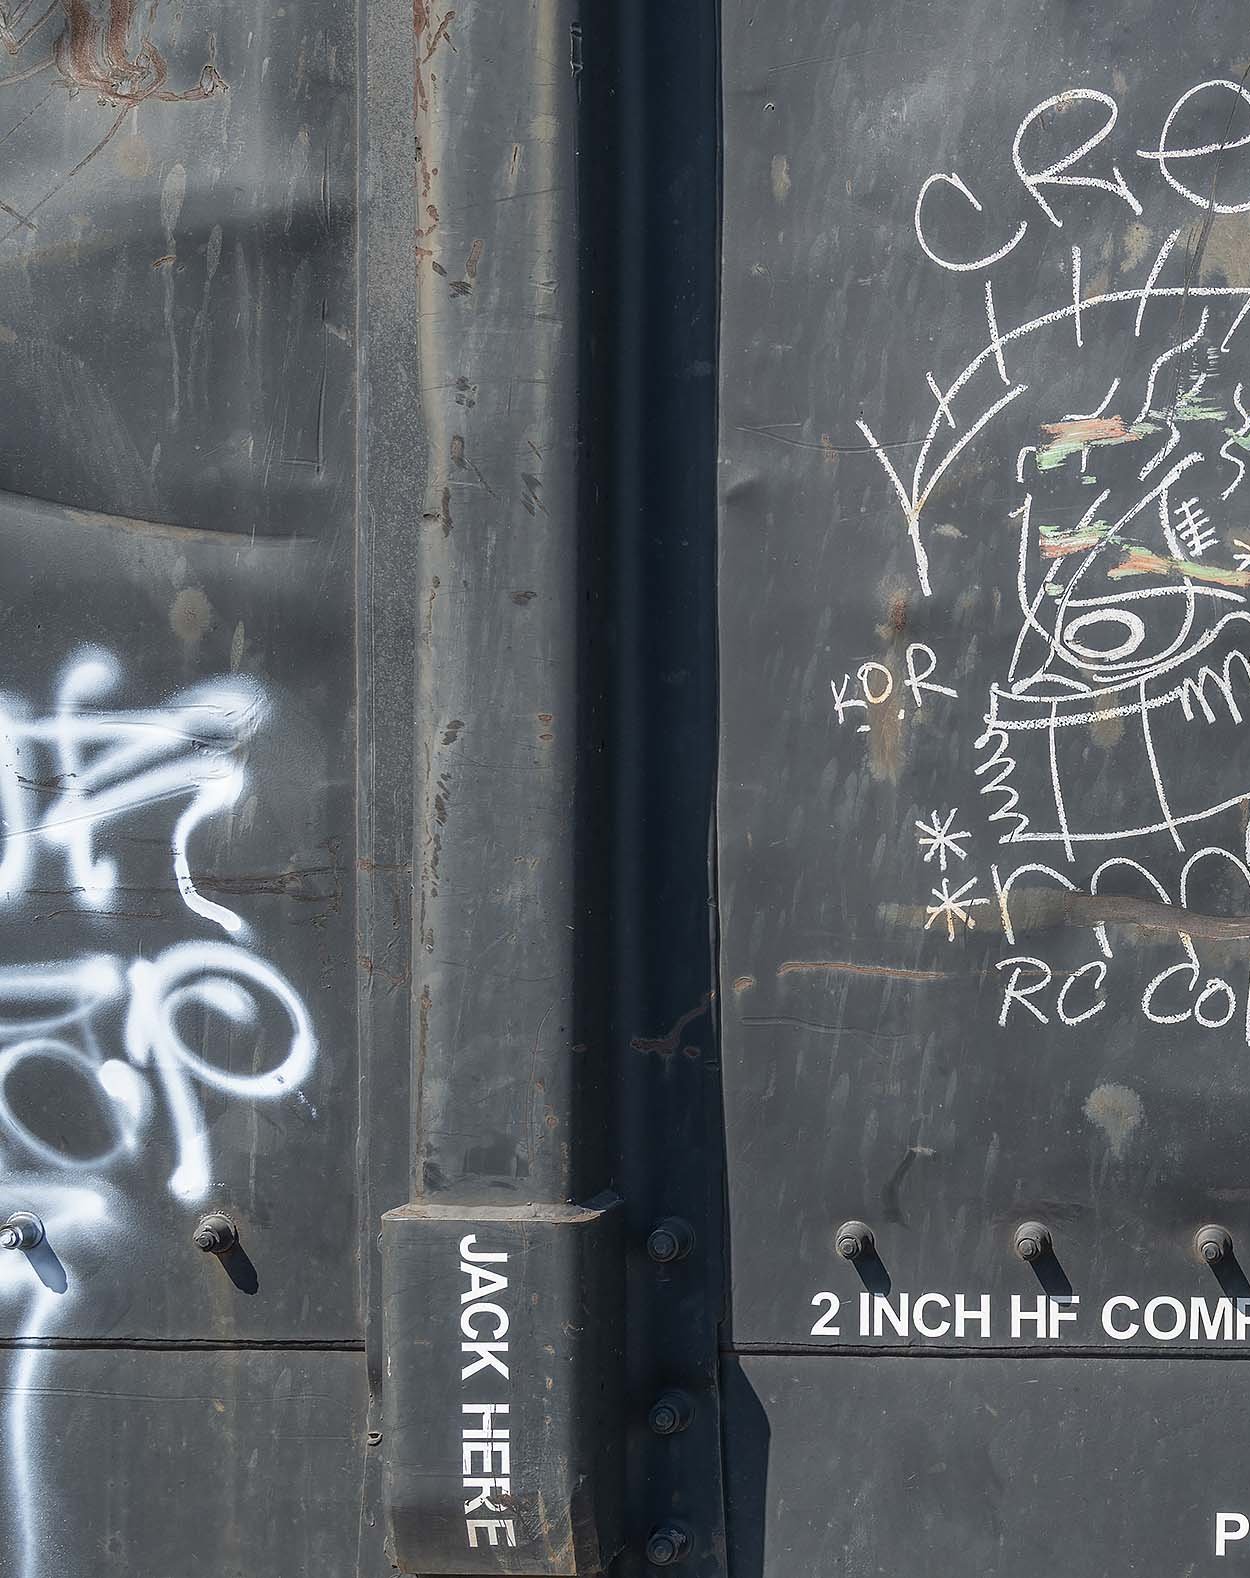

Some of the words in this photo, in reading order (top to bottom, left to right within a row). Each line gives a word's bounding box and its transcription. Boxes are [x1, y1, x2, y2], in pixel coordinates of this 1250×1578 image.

[995, 956, 1107, 1027] RC
[459, 1233, 511, 1381] JACK
[809, 1291, 842, 1337] 2
[859, 1292, 992, 1339] INCH
[1010, 1294, 1081, 1339] HF
[461, 1403, 518, 1548] HERE
